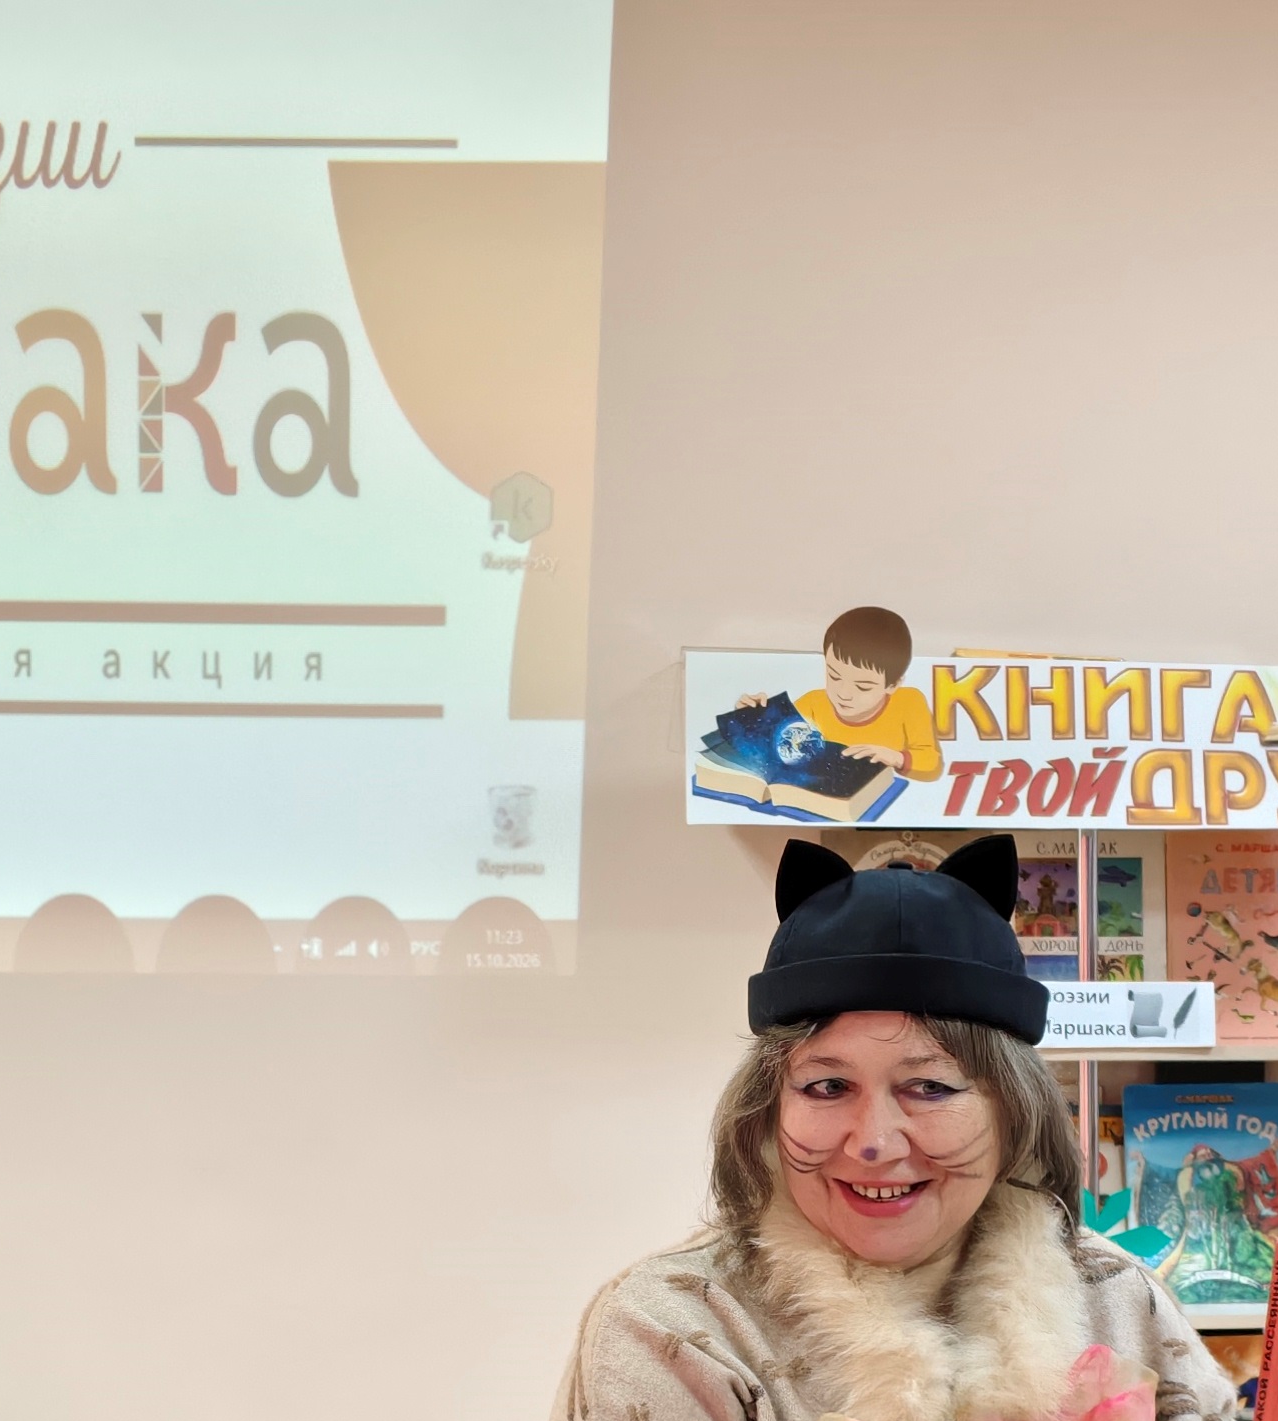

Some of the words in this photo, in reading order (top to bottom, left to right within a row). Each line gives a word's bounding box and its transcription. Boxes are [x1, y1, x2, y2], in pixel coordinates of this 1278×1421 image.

[101, 646, 325, 690] акция
[942, 745, 1129, 818] ТВОЙ
[409, 940, 442, 957] РУС
[1049, 991, 1111, 1005] оэзии
[1132, 1106, 1229, 1143] КРУГЛЫЙ
[1235, 1113, 1278, 1145] ГОД
